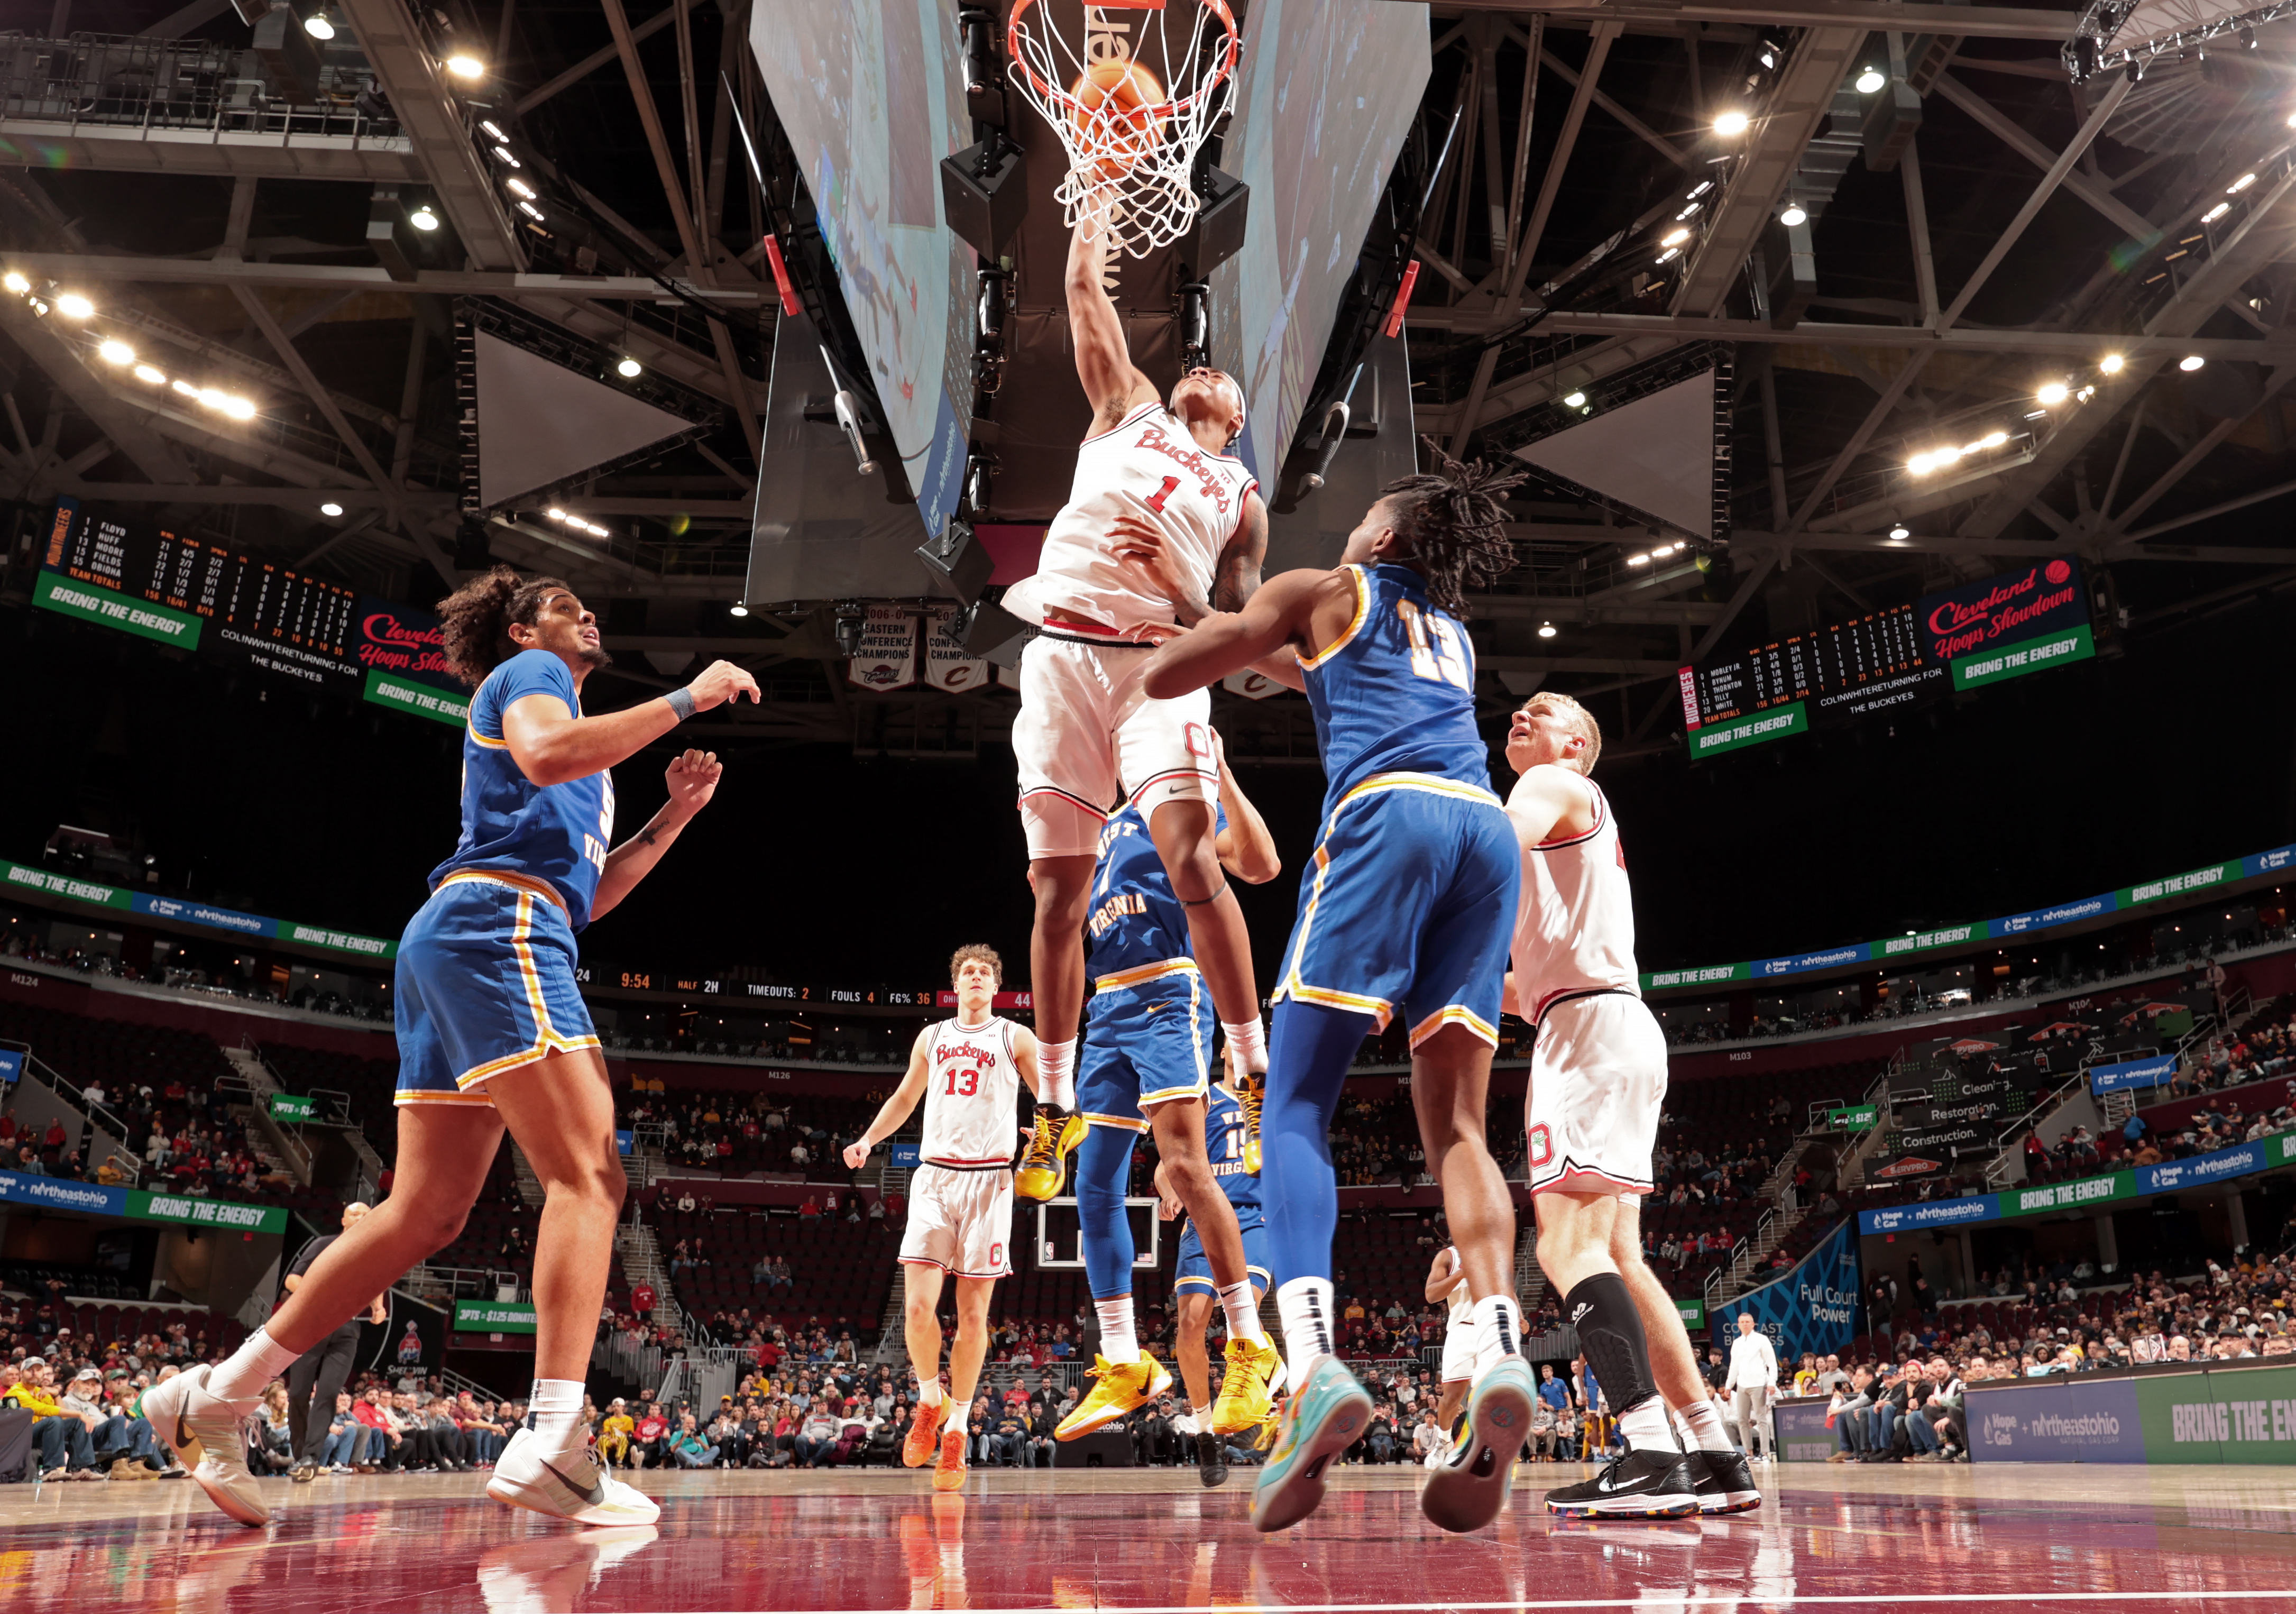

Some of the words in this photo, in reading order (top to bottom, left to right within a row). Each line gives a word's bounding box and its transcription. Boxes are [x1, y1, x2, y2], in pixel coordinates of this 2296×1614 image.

[1134, 429, 1230, 513] Buckeyes
[1144, 476, 1181, 513] 1
[100, 522, 126, 537] FLOYD
[79, 536, 88, 546] 13
[96, 542, 124, 557] MOORE
[98, 532, 120, 545] HUFF
[76, 546, 86, 556] 15
[93, 551, 121, 567] FIELDS
[72, 556, 84, 566] 55
[91, 561, 121, 577] OBIOHA
[69, 567, 91, 581] TEAM
[92, 573, 121, 590] TOTALS
[145, 589, 160, 601] 156
[166, 595, 187, 608] 16/41
[1928, 568, 2036, 635] Cleveland
[50, 586, 100, 612] BRING
[100, 601, 130, 620] THE
[128, 609, 186, 636] ENERGY
[865, 624, 905, 634] EASTERN
[1935, 627, 1985, 658] Hoops
[1987, 586, 2075, 638] Showdown
[363, 614, 445, 649] Clevela
[860, 637, 913, 647] ONFERENCE
[1397, 599, 1471, 696] 13
[221, 628, 336, 671] COLINWHITERETURNING
[338, 664, 359, 677] FOR
[334, 646, 343, 656] 55
[359, 644, 411, 670] Hoops
[857, 648, 910, 659] CHAMPIONS
[931, 649, 982, 660] CHAMPION
[1966, 658, 2003, 679] BRING
[2004, 652, 2027, 668] THE
[2029, 638, 2078, 662] ENERGY
[251, 654, 269, 668] THE
[271, 660, 324, 684] BUCKEYES.
[1711, 665, 1733, 677] MOBLEY
[1875, 668, 1883, 677] 13
[1899, 662, 1907, 671] 13
[1712, 675, 1732, 686] BYNUM
[1713, 681, 1742, 694] THORNTON
[1821, 674, 1921, 707] COLINWHITERETURNING
[1923, 668, 1942, 680] FOR
[376, 682, 416, 703] BRING
[416, 693, 439, 710] THE
[437, 700, 469, 720] ENER
[1680, 672, 1700, 725] BUCKEYES
[1714, 693, 1729, 702] TILLY
[1772, 694, 1789, 704] 16/44
[1796, 689, 1809, 699] 2/14
[1850, 703, 1867, 714] THE
[1868, 691, 1916, 710] BUCKEYES.
[1715, 700, 1733, 711] WHITE
[1704, 715, 1719, 724] TEAM
[1720, 709, 1740, 720] TOTALS
[1700, 730, 1731, 749] BRING
[1733, 725, 1752, 740] THE
[1754, 713, 1794, 735] ENERGY
[584, 833, 607, 876] VIRG
[2268, 850, 2290, 861] Hope
[2270, 859, 2285, 867] Gas
[8, 866, 46, 887] BRING
[46, 875, 68, 893] THE
[67, 882, 113, 902] ENERGY
[2132, 882, 2163, 902] BRING
[2163, 877, 2183, 894] THE
[2183, 866, 2224, 889] ENERGY
[160, 901, 183, 911] Hope
[2012, 916, 2032, 925] Hope
[293, 927, 327, 944] BRING
[327, 932, 347, 948] THE
[346, 936, 387, 954] ENERGY
[1885, 937, 1914, 954] BRING
[1916, 933, 1934, 948] THE
[1934, 927, 1971, 945] ENERGY
[11, 973, 39, 987] M124
[576, 968, 590, 982] 24
[621, 972, 650, 988] 9:54
[1652, 972, 1680, 987] BRING
[1681, 970, 1698, 983] THE
[1700, 966, 1734, 981] ENERGY
[678, 980, 698, 990] HALF
[704, 979, 719, 994] 2H
[747, 984, 796, 998] TIMEOUTS:
[802, 987, 809, 1000] 2
[831, 991, 861, 1002] FOULS
[867, 992, 874, 1004] 4
[889, 993, 911, 1004] FG%
[917, 992, 930, 1005] 36
[1015, 993, 1031, 1007] 44
[936, 1041, 996, 1068] Buckeyes
[1730, 1052, 1752, 1061] M103
[768, 1071, 791, 1079] M126
[945, 1069, 979, 1096] 13
[1221, 1111, 1246, 1125] WE
[1903, 1129, 1977, 1148] Construction.
[1212, 1162, 1246, 1176] VIRG
[1890, 1162, 1928, 1175] SERVPRO
[2160, 1167, 2183, 1177] Hope
[2161, 1177, 2178, 1186] Gas
[2021, 1188, 2054, 1210] BRING
[2055, 1185, 2074, 1204] THE
[2075, 1177, 2115, 1201] ENERGY
[149, 1196, 192, 1218] BRING
[192, 1201, 218, 1221] THE
[215, 1205, 267, 1227] ENERGY
[1881, 1212, 1903, 1221] Hope
[1801, 1284, 1823, 1303] Full
[1825, 1287, 1859, 1306] Court
[459, 1309, 481, 1320] 3PTS
[486, 1310, 508, 1322] $125
[1812, 1304, 1850, 1324] Power
[1723, 1323, 1784, 1333] COAST
[1991, 1413, 2017, 1432] Hope
[2172, 1402, 2229, 1442] BRING
[2230, 1400, 2270, 1441] THE
[1994, 1429, 2013, 1445] Gas
